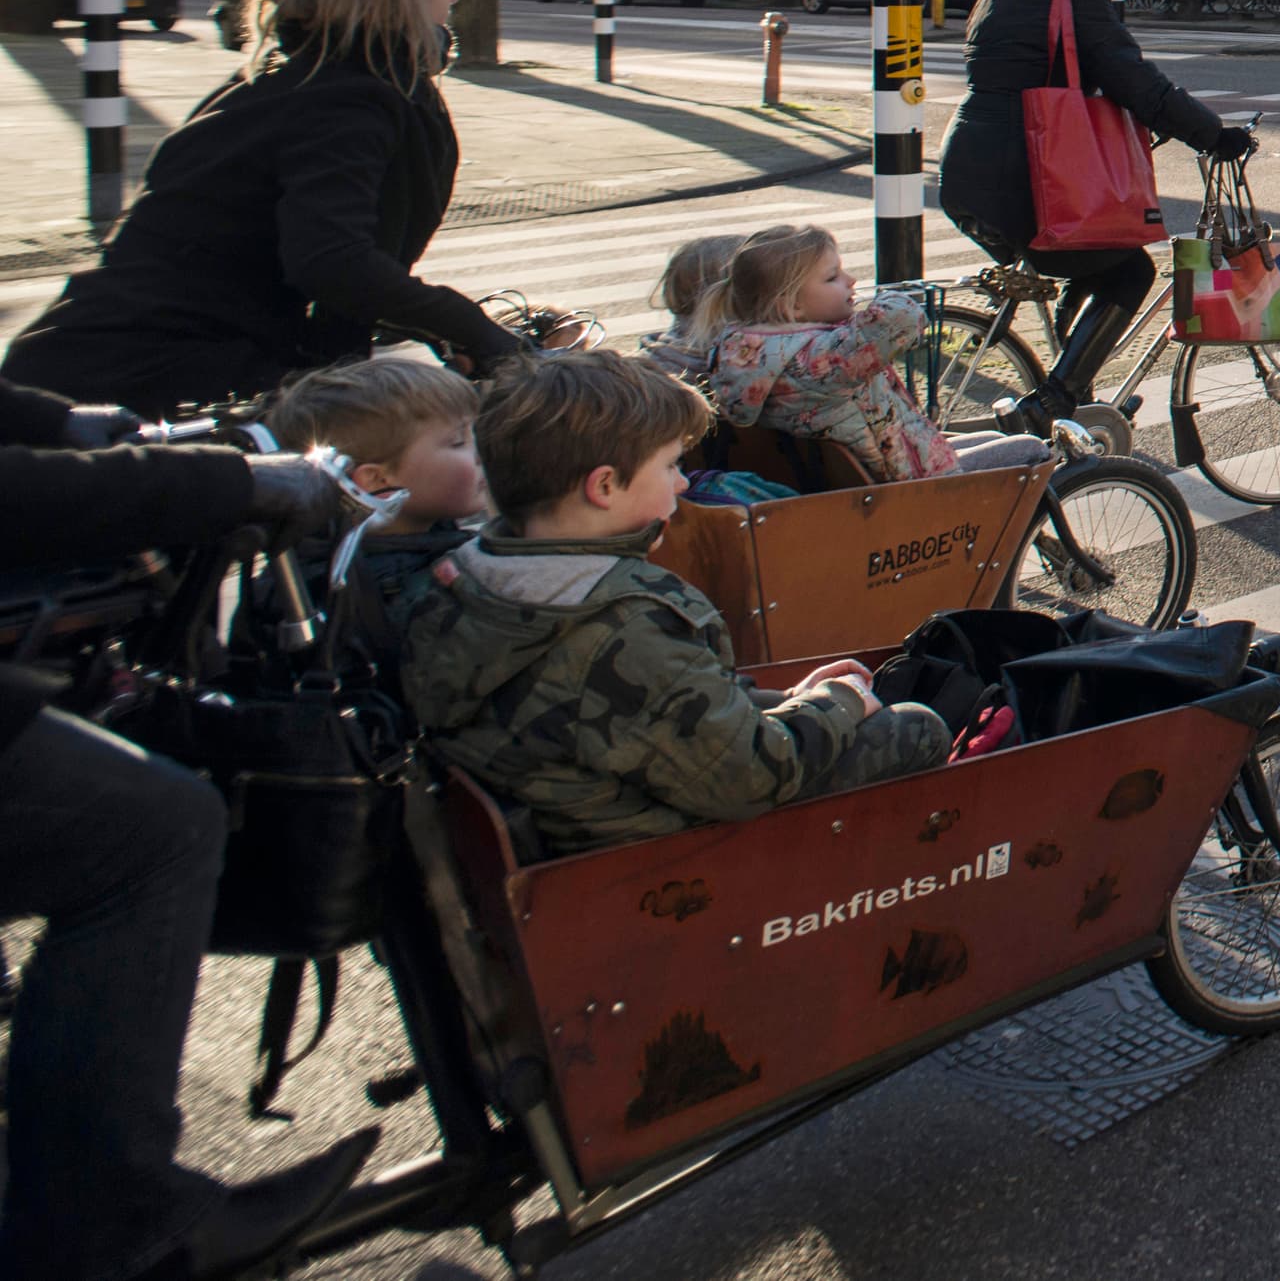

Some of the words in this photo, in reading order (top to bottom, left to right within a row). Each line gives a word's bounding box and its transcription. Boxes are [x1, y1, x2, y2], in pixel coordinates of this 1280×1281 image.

[867, 532, 953, 577] BABBOE
[952, 522, 980, 542] City
[762, 854, 984, 947] Bakfiets.nl
